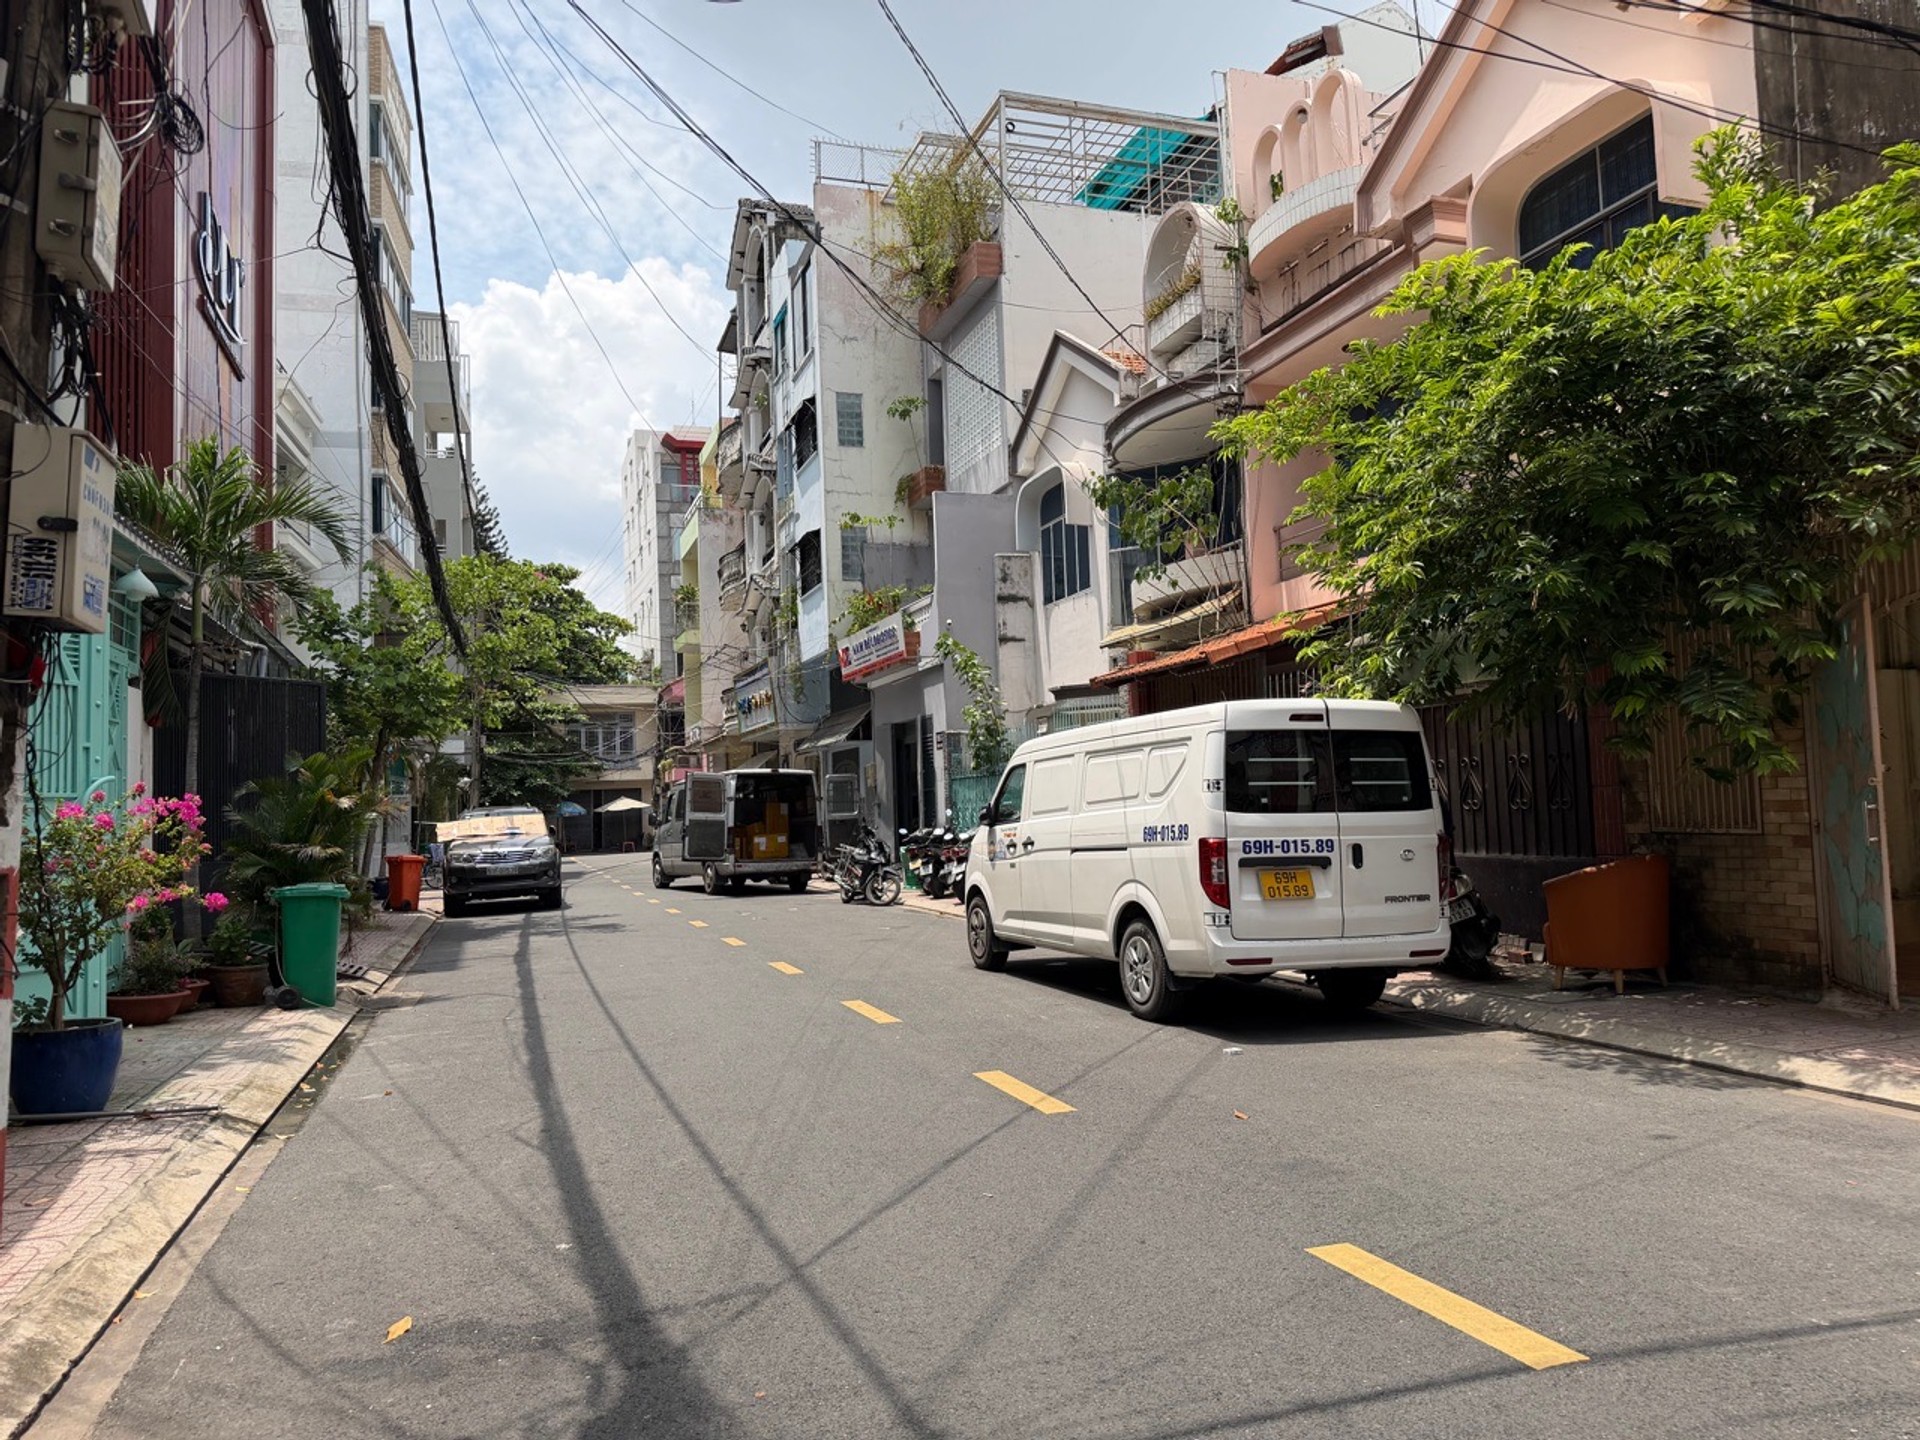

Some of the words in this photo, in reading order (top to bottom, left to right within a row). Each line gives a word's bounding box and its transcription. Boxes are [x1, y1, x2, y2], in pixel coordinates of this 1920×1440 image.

[1143, 823, 1189, 842] 69H-015.89
[1242, 838, 1335, 855] 69H-015.89
[1273, 871, 1298, 884] 69H
[1267, 884, 1309, 898] 015.89
[1384, 894, 1431, 904] FRONTIER
